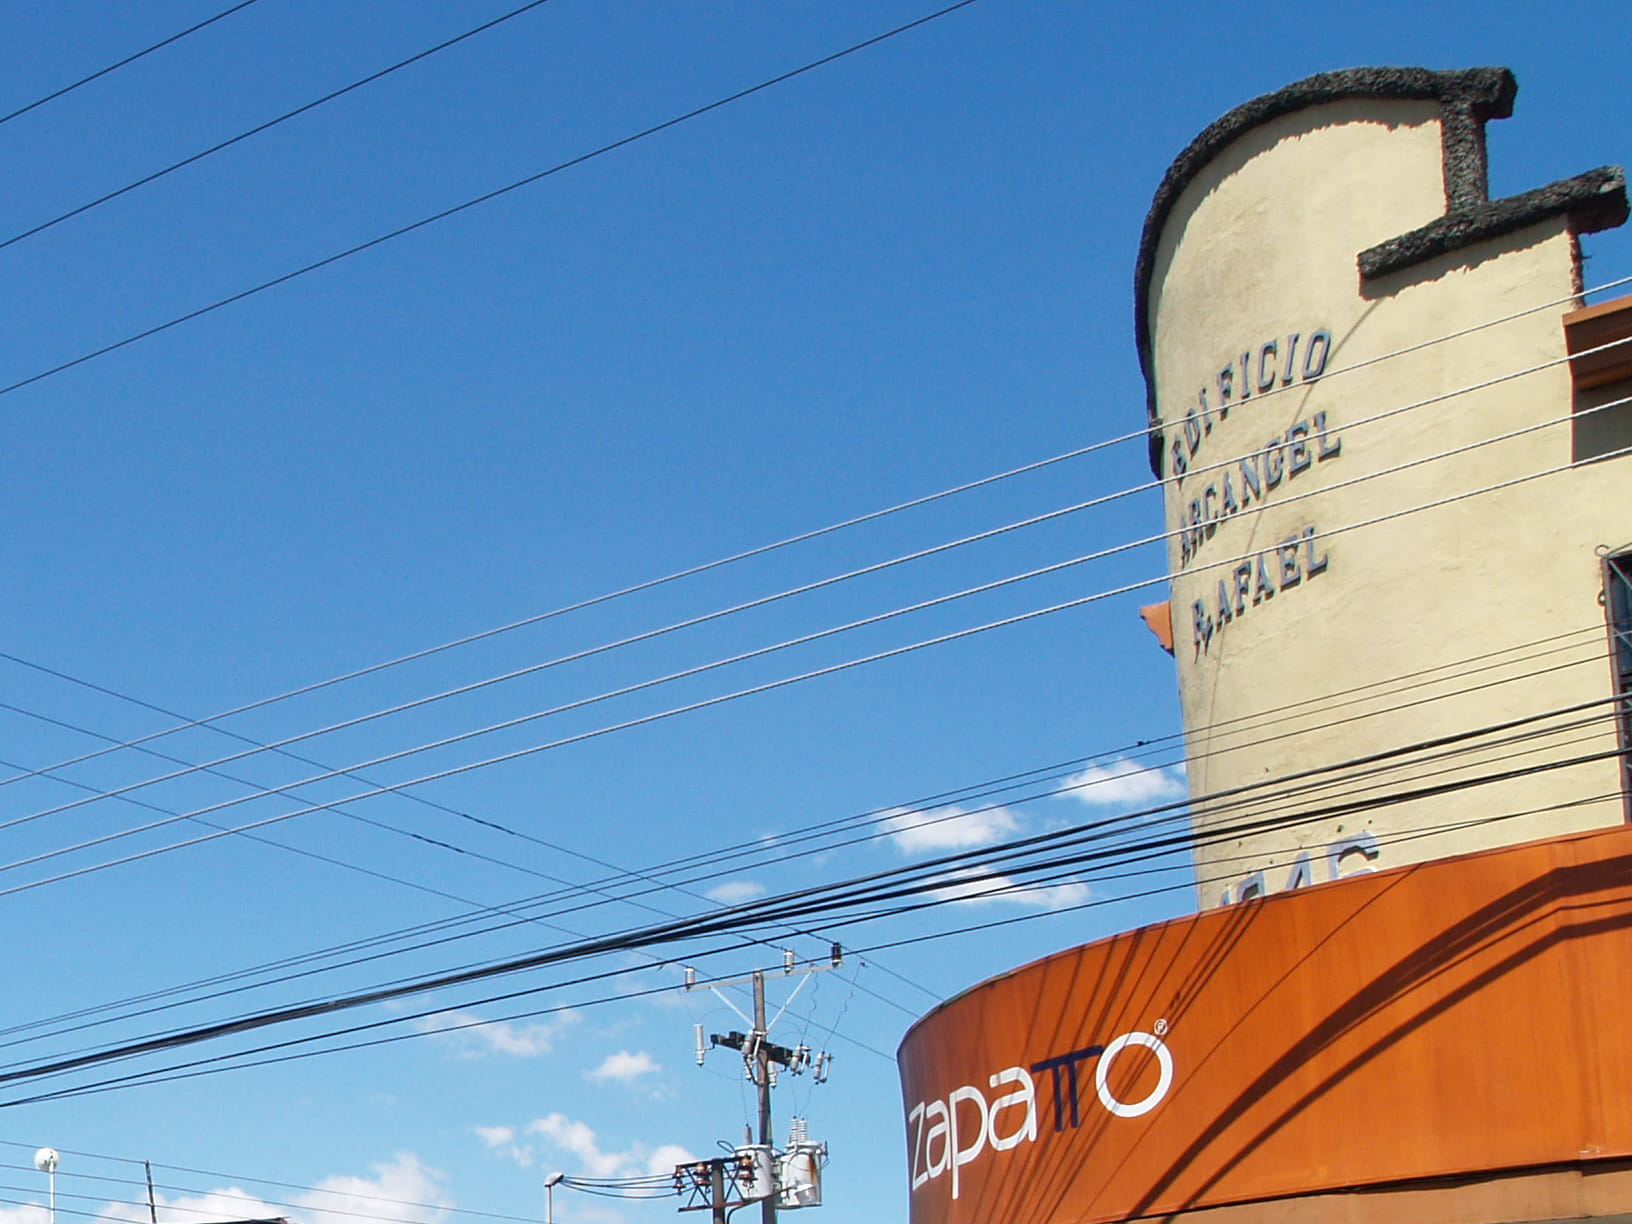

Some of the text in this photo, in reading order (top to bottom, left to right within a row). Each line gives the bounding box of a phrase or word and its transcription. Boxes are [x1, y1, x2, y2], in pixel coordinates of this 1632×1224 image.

[1171, 329, 1331, 489] EDIFICIO
[1179, 411, 1341, 569] ARCANGEL
[1191, 526, 1328, 662] RAFAEL
